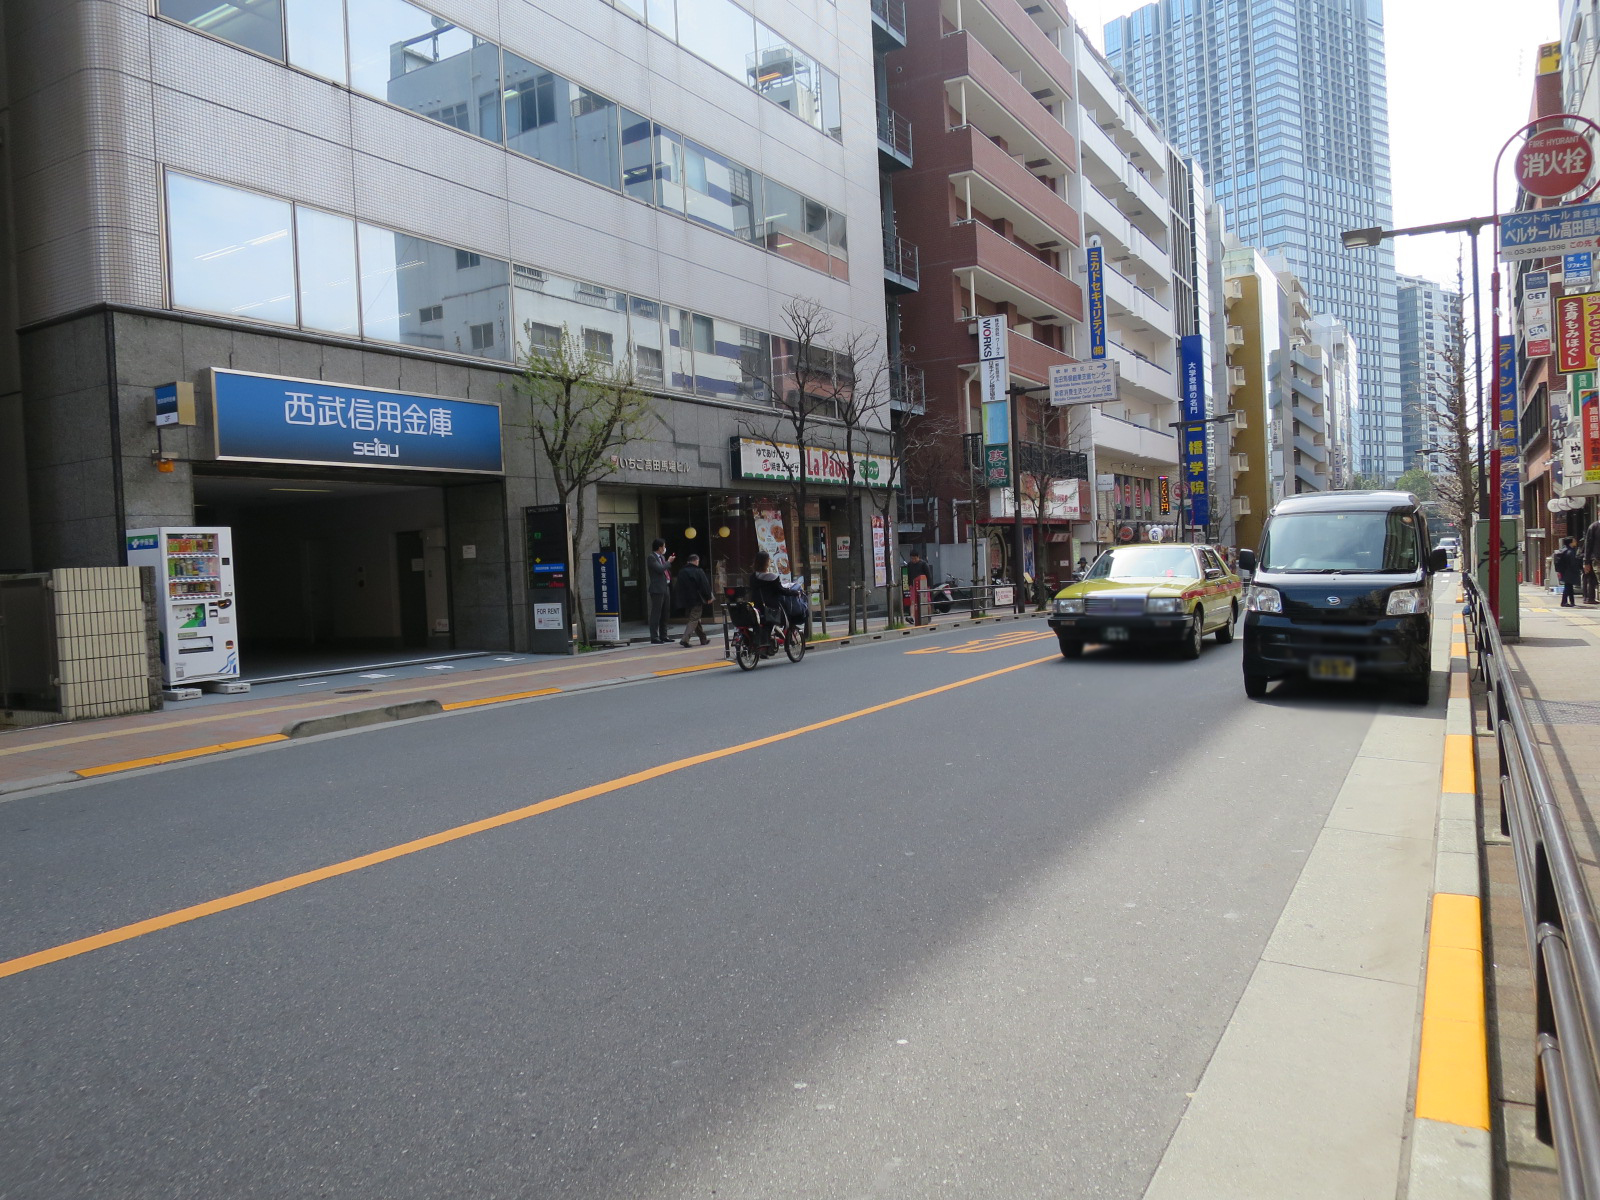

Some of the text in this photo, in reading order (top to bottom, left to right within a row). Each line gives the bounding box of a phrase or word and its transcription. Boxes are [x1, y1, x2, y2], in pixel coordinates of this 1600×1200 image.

[1528, 136, 1580, 148] FIRE HYDRANT
[1522, 146, 1587, 179] 消火栓
[1505, 212, 1570, 227] イベントホール
[1570, 240, 1592, 248] この先
[1528, 292, 1546, 300] GET
[983, 319, 992, 358] WORKS
[1564, 301, 1580, 366] 全身もみほぐし
[1188, 362, 1198, 414] 大学受験の名門
[284, 392, 453, 438] 西武信用金庫
[619, 458, 690, 473] いちご高田馬場ビル
[807, 449, 820, 476] La
[1188, 426, 1205, 494] 一橋学院
